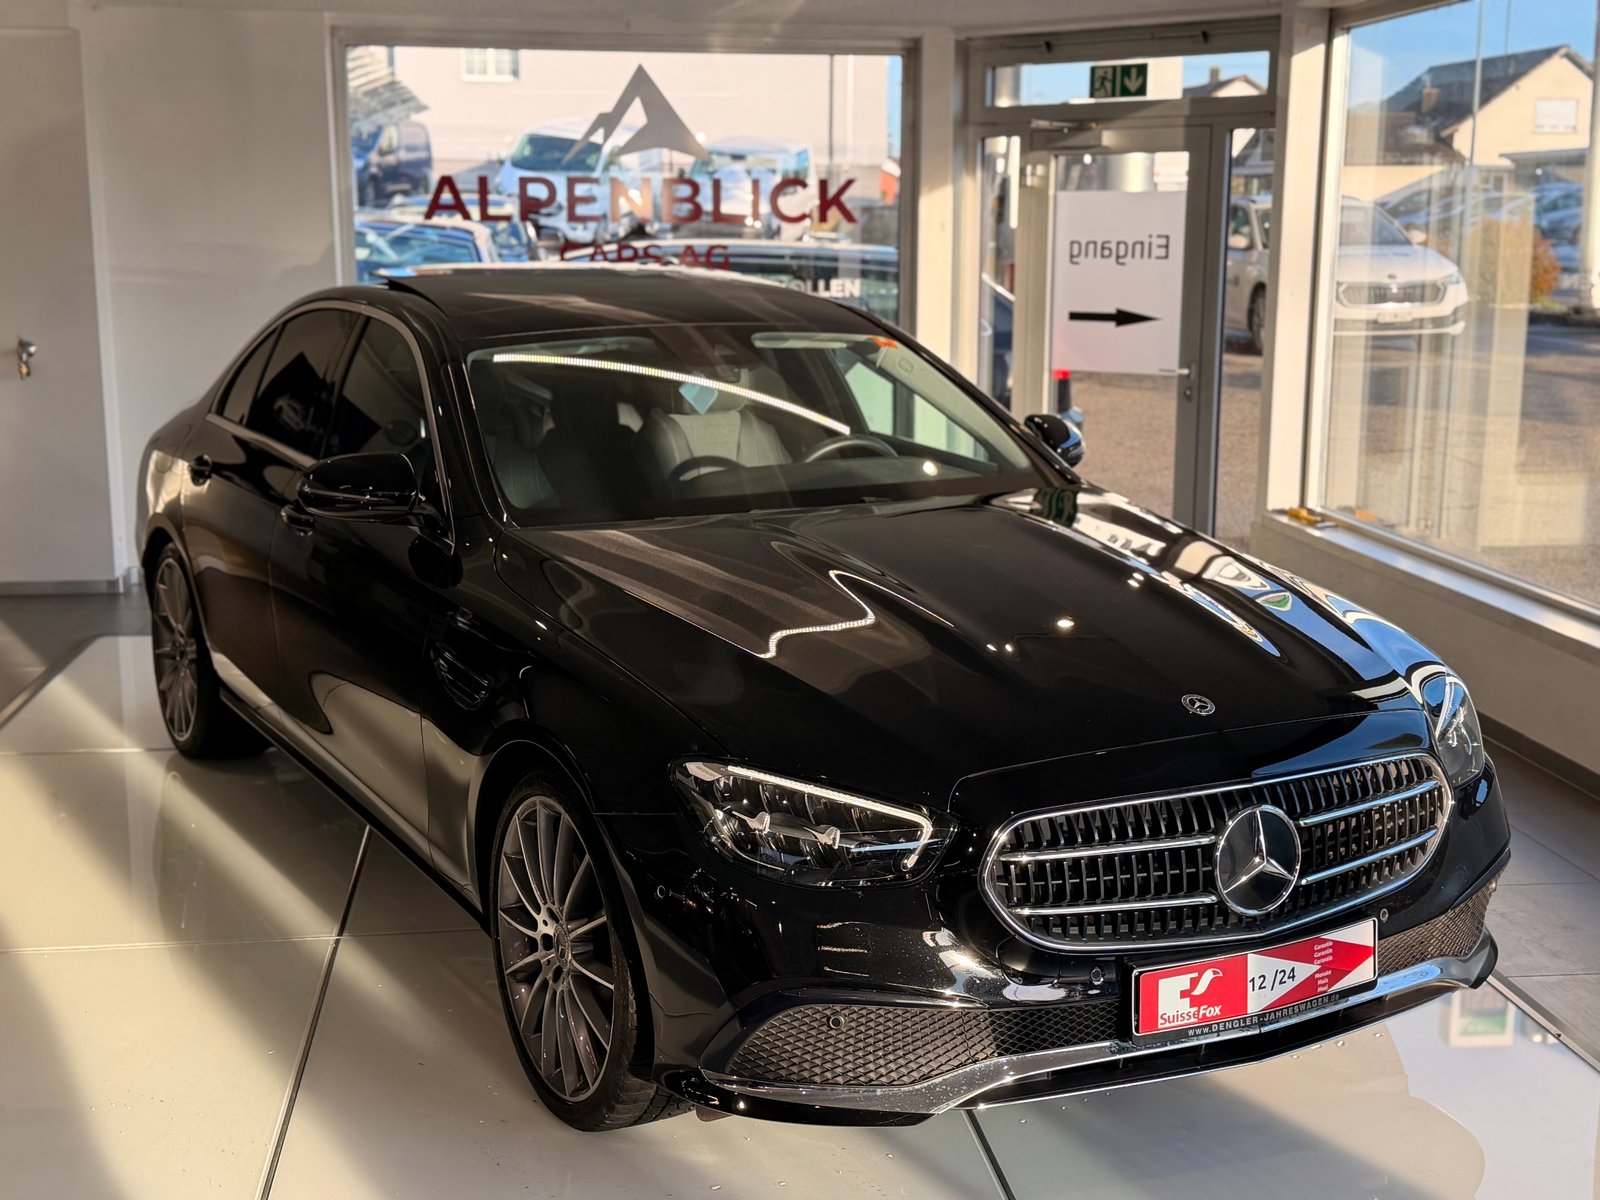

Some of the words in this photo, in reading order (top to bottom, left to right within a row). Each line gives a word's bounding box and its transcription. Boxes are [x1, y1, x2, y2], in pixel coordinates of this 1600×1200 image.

[424, 175, 858, 224] ALPENBLICK
[680, 245, 731, 270] AG
[1187, 993, 1340, 1037] www.DENGLER-JAHRESWAGEN.de
